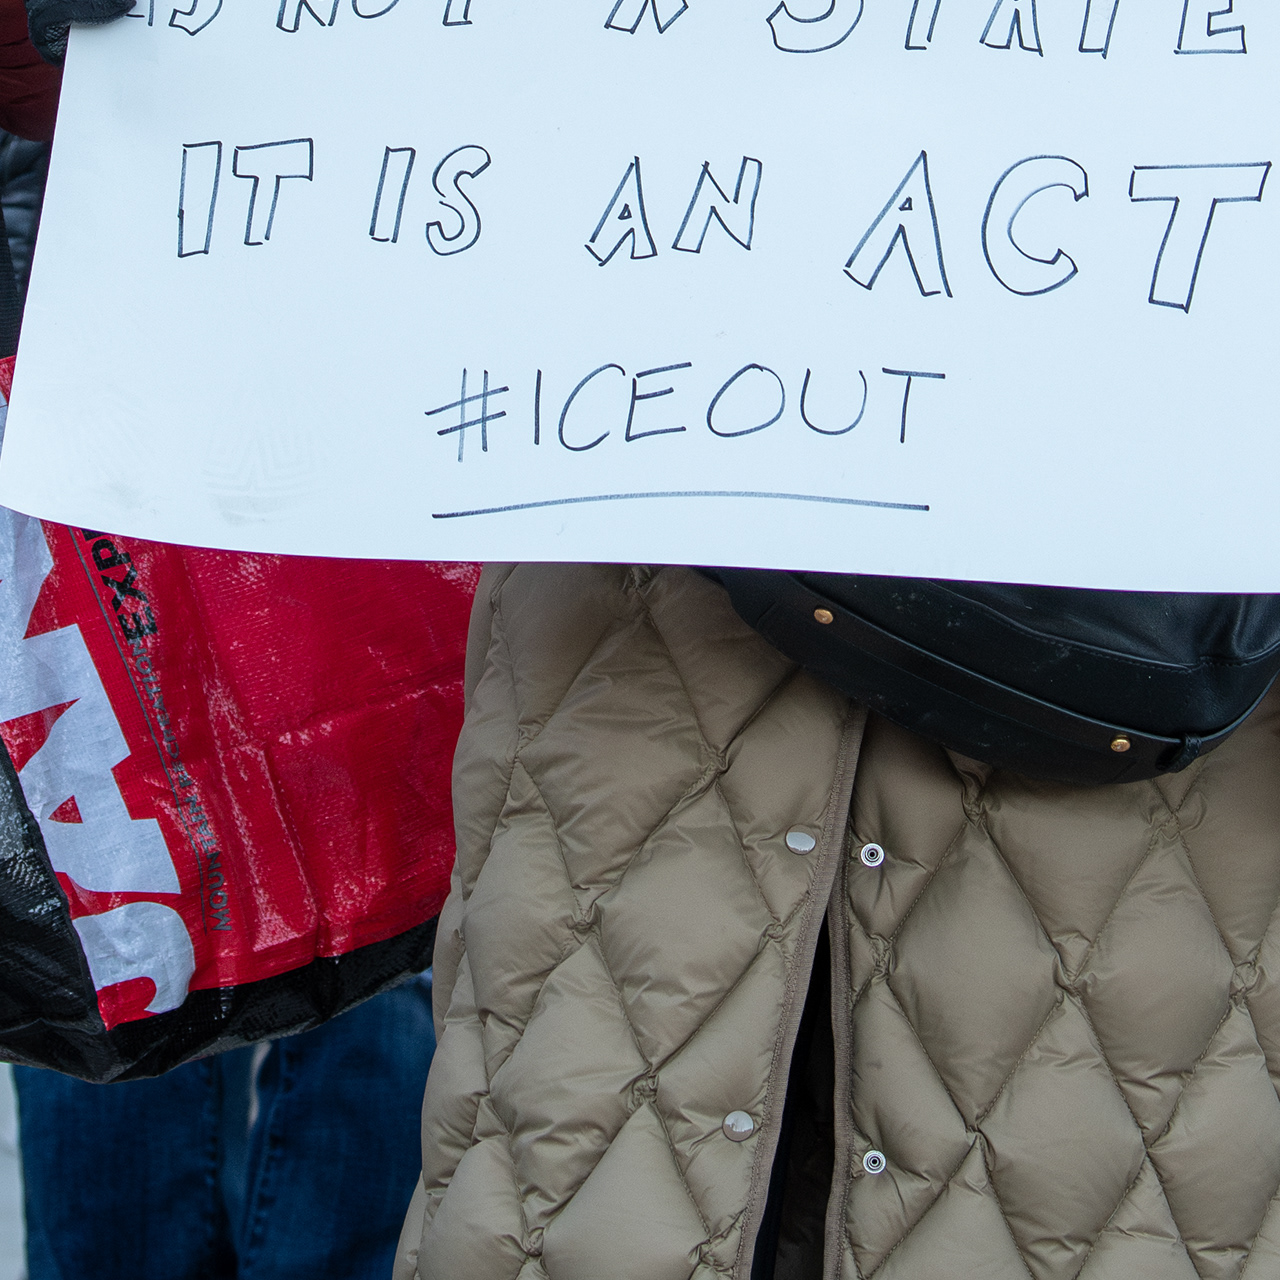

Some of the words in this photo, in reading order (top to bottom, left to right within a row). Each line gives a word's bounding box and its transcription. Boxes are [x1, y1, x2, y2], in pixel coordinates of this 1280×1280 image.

[177, 138, 313, 258] IT
[369, 144, 492, 256] IS
[584, 155, 763, 266] AN
[842, 151, 1273, 314] ACT
[425, 362, 947, 464] #ICEOUT
[132, 637, 195, 789] RECREATION
[186, 793, 233, 931] MOUNTAIN
